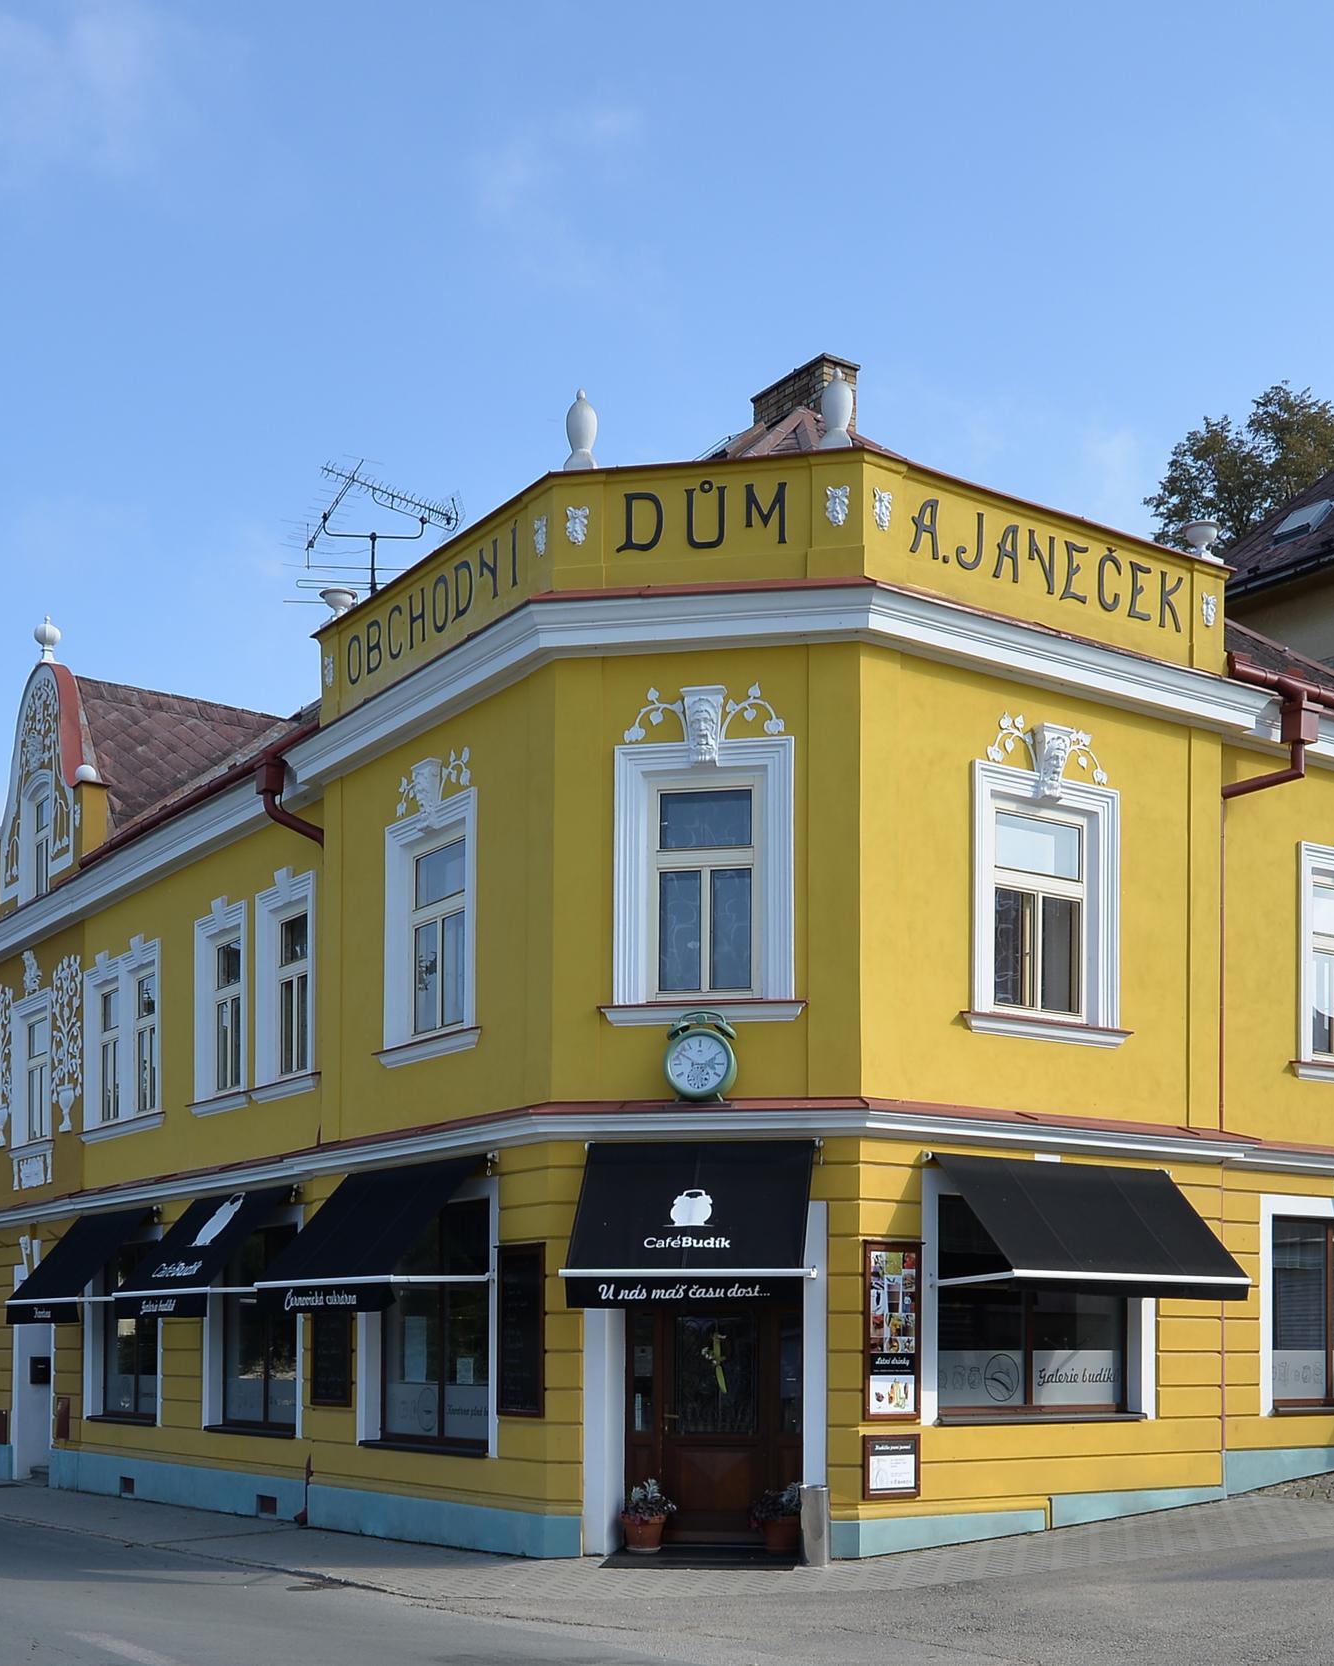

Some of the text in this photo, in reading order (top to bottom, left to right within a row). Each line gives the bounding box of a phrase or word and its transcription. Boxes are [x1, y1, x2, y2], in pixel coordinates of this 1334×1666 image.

[347, 519, 519, 686] OBCHODNÍ
[615, 479, 788, 552] DŮM
[643, 1234, 731, 1248] CaféBudík
[598, 1283, 770, 1300] U nás máš času dost...
[1037, 1367, 1079, 1387] Galerie
